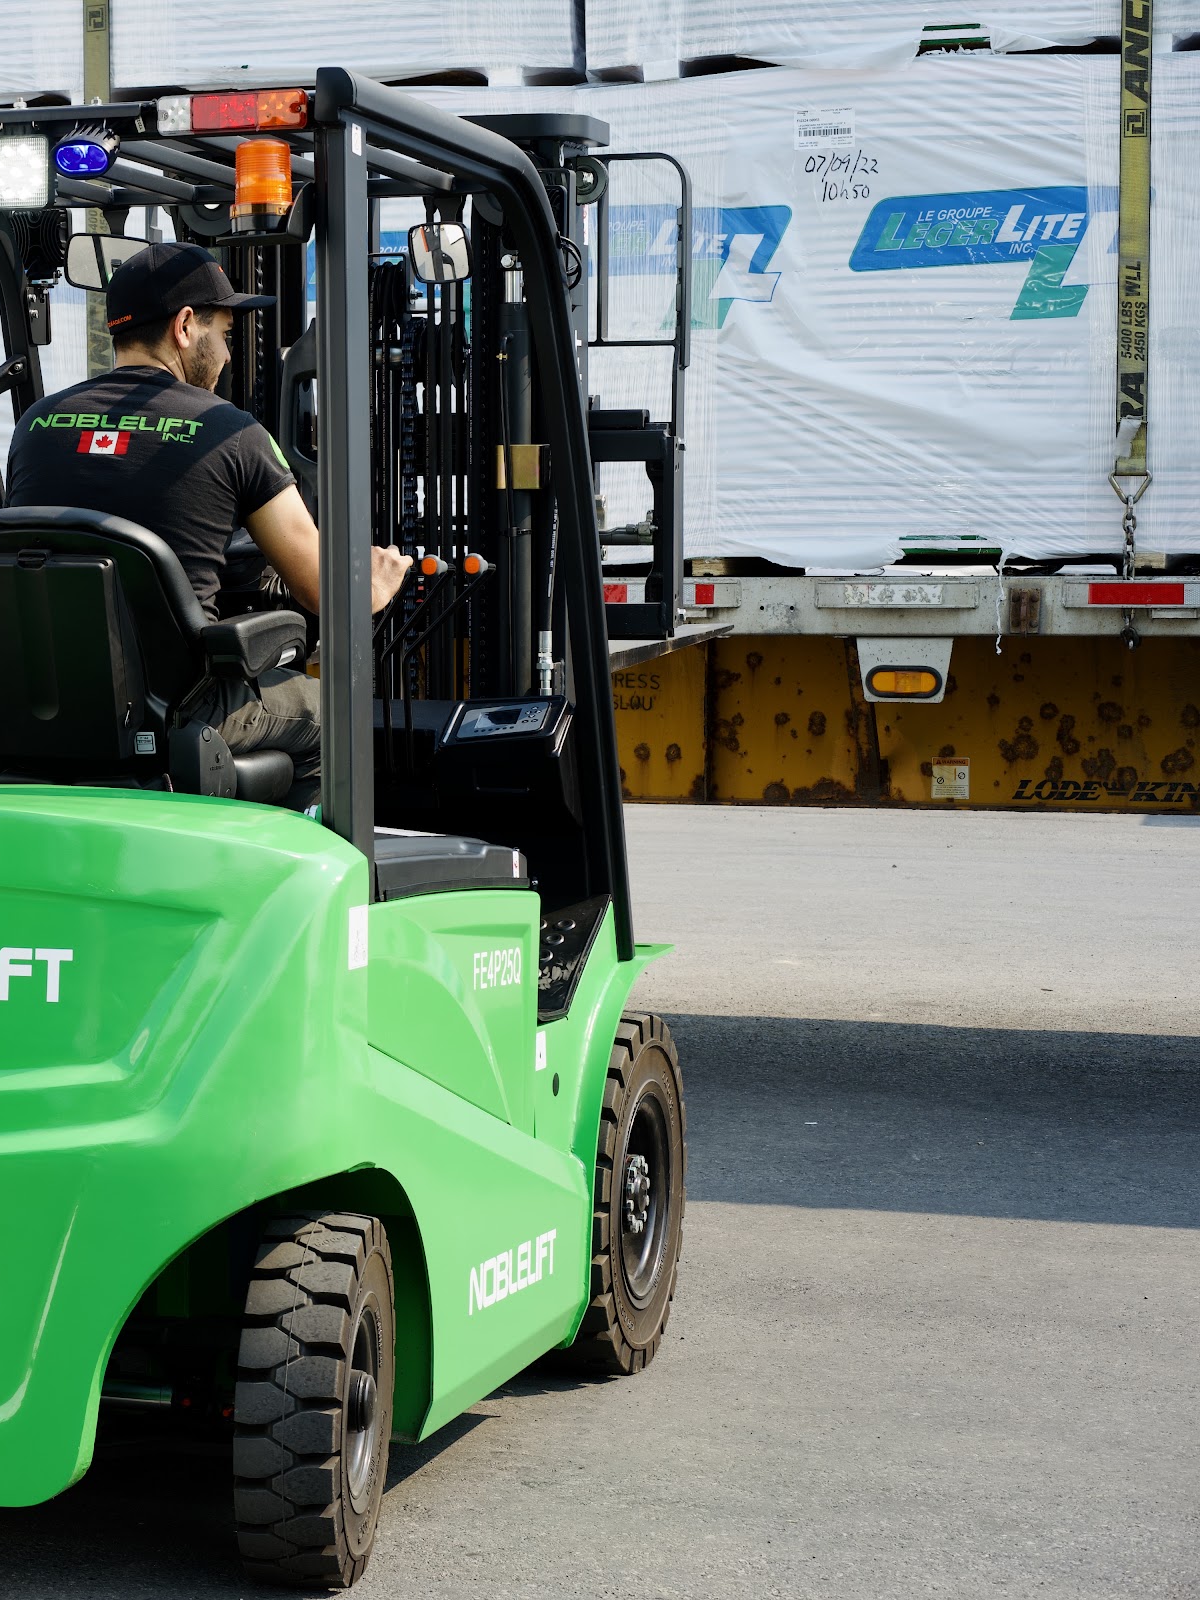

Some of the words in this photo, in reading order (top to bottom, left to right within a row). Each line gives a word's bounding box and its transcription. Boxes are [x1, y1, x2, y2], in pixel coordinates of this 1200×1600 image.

[1125, 0, 1150, 104] ANC
[804, 149, 879, 183] 07/09/22
[917, 211, 935, 222] LE
[937, 206, 992, 220] GROUPE
[1009, 243, 1035, 254] INC.
[1125, 261, 1142, 297] WLL
[1121, 301, 1133, 326] LBS
[1134, 301, 1146, 328] KGS
[1120, 328, 1133, 360] 5400
[1134, 332, 1146, 362] 2450
[29, 413, 204, 436] NOBLELIFT
[161, 432, 194, 444] INC.
[611, 672, 661, 690] RESS
[1012, 779, 1102, 801] LODE
[473, 946, 522, 991] FE4P25Q
[468, 1227, 557, 1316] NOBLELIFT
